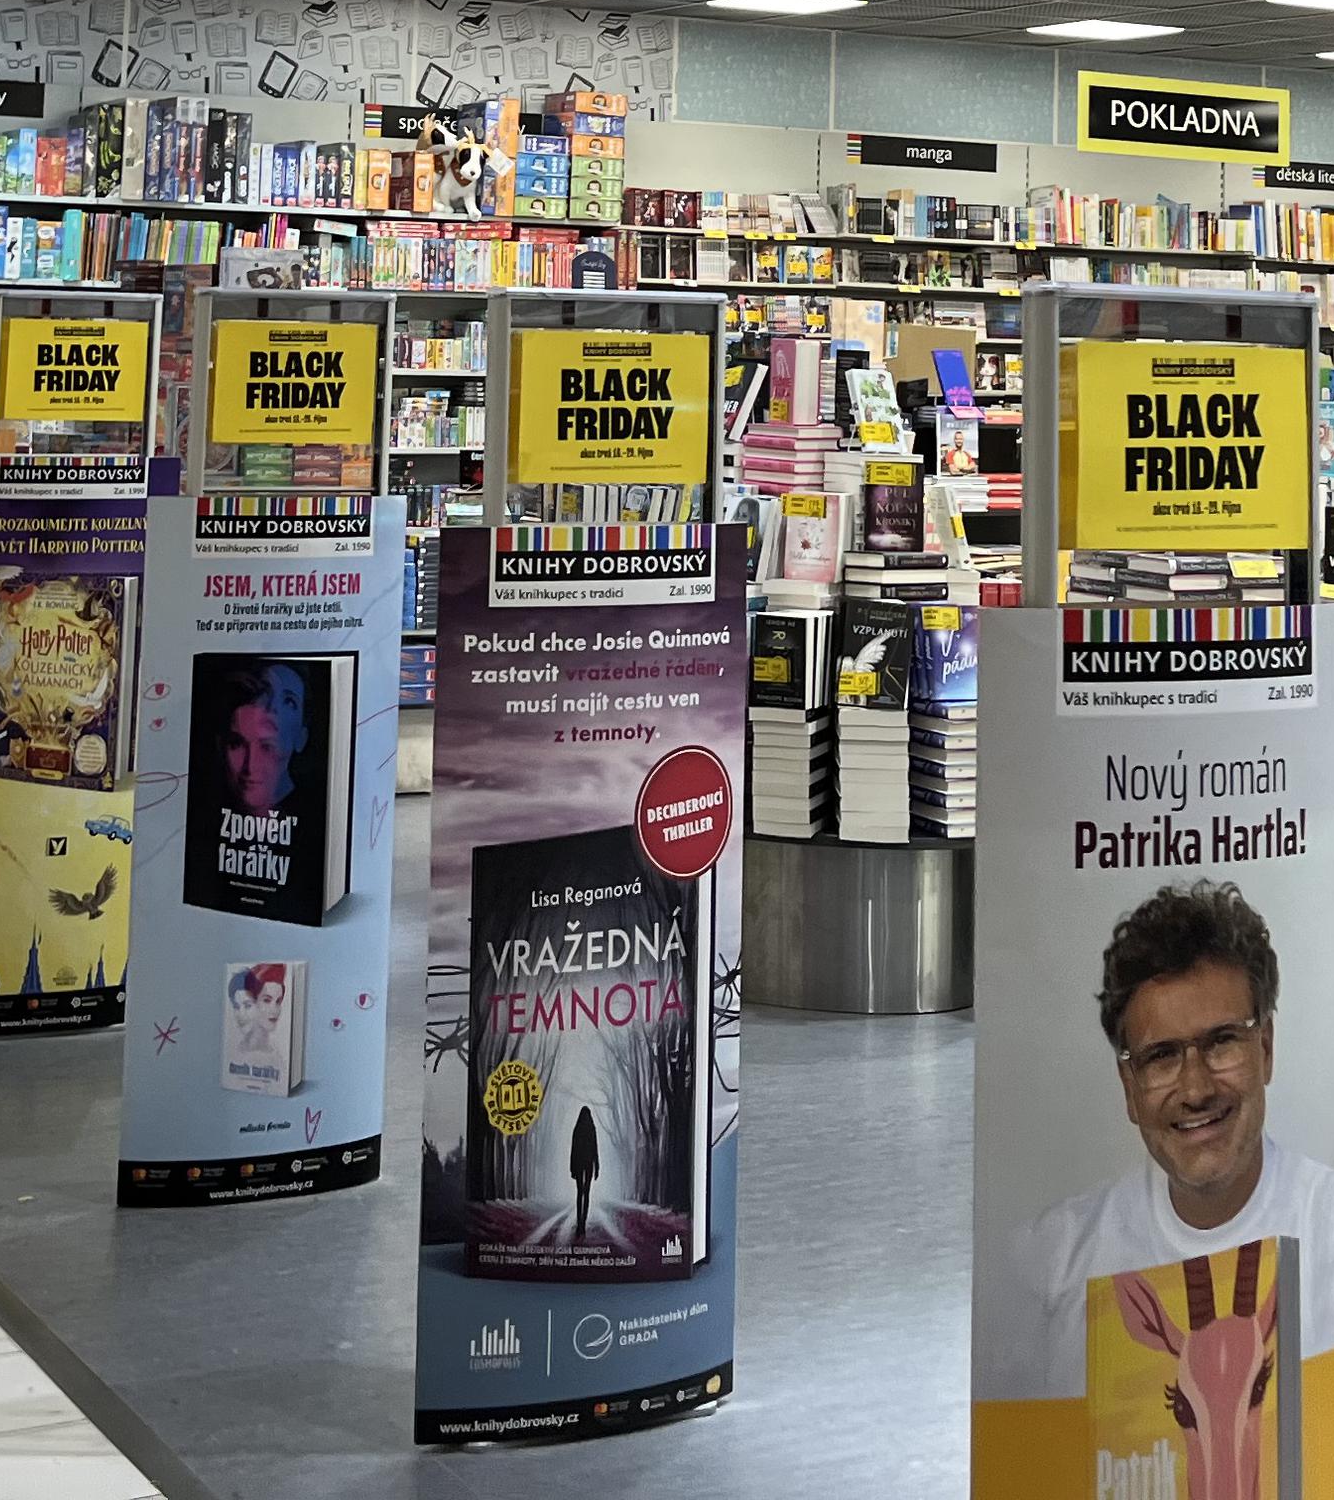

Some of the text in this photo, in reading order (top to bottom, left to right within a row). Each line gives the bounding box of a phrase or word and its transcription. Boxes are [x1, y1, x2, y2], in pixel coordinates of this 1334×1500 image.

[1110, 99, 1260, 139] POKLADNA
[906, 145, 953, 164] manga
[1276, 167, 1315, 183] dětská
[37, 343, 120, 367] BLACK
[249, 350, 344, 379] BLACK
[33, 369, 121, 392] FRIDAY
[560, 367, 672, 402] BLACK
[245, 381, 347, 410] FRIDAY
[557, 406, 674, 442] FRIDAY
[1126, 394, 1262, 438] BLACK
[3, 466, 142, 480] KNIHY DOBROVSKÝ
[1124, 445, 1265, 492] FRIDAY
[201, 517, 367, 534] KNIHY DOBROVSKÝ
[28, 537, 89, 555] HARRYHO
[91, 536, 145, 553] POTTERA
[196, 544, 212, 552] Váš
[501, 550, 707, 575] KNIHY DOBROVSKÝ
[204, 570, 361, 599] JSEM, KTERÁ JSEM
[495, 585, 712, 601] Váš knihkupec s tradicí Zal. 1990
[271, 621, 282, 630] na
[283, 620, 308, 630] cestu
[309, 618, 320, 629] do
[852, 623, 909, 639] VZPLANUTÍ
[20, 624, 94, 656] Harry Potter
[464, 626, 731, 652] Pokud chce Josie Quinnová
[1071, 640, 1307, 674] KNIHY DOBROVSKÝ
[23, 675, 83, 690] ALMANACH
[471, 663, 559, 684] zastavit
[567, 661, 660, 681] vražedné
[506, 691, 700, 716] musí najít cestu ven
[1062, 684, 1314, 708] Váš knihkupec s tradicí Zal. 1990
[554, 723, 661, 743] z temnoty.
[1107, 745, 1286, 811] Nový román
[647, 786, 724, 824] DECHBEROUCÍ
[219, 808, 298, 846] Zpověď
[662, 816, 713, 842] THRILLER
[1074, 807, 1306, 869] Patrika Hartla!
[218, 845, 291, 886] farářky
[531, 877, 642, 908] Lisa Reganová
[487, 906, 687, 980] VRAŽEDNÁ
[487, 979, 685, 1034] TEMNOTA
[487, 1091, 540, 1132] BESTSELLER
[618, 1302, 709, 1332] Nakladatelský dům
[618, 1330, 659, 1347] GRADA
[439, 1411, 580, 1434] www.knihydobrovsky.cz
